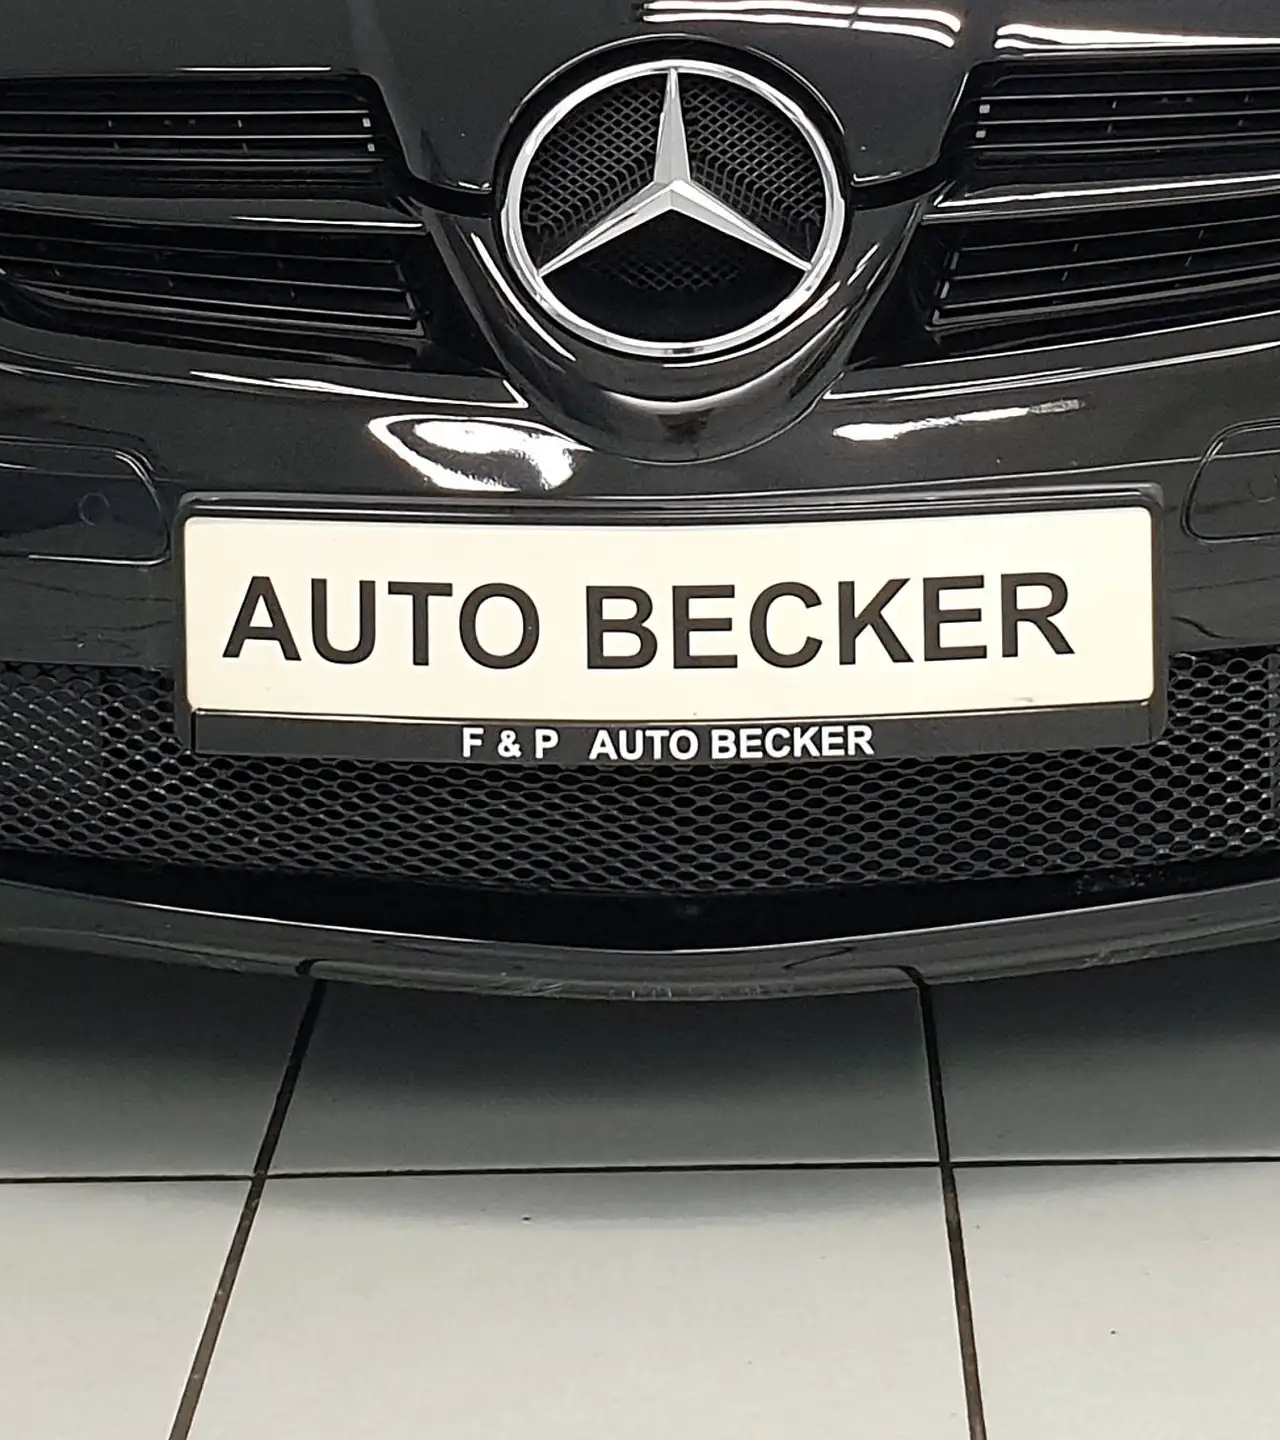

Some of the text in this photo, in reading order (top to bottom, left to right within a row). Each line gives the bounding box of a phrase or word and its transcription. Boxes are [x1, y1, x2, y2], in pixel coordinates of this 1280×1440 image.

[222, 572, 1076, 670] AUTO BECKER
[462, 724, 875, 761] F & P AUTO BECKER
